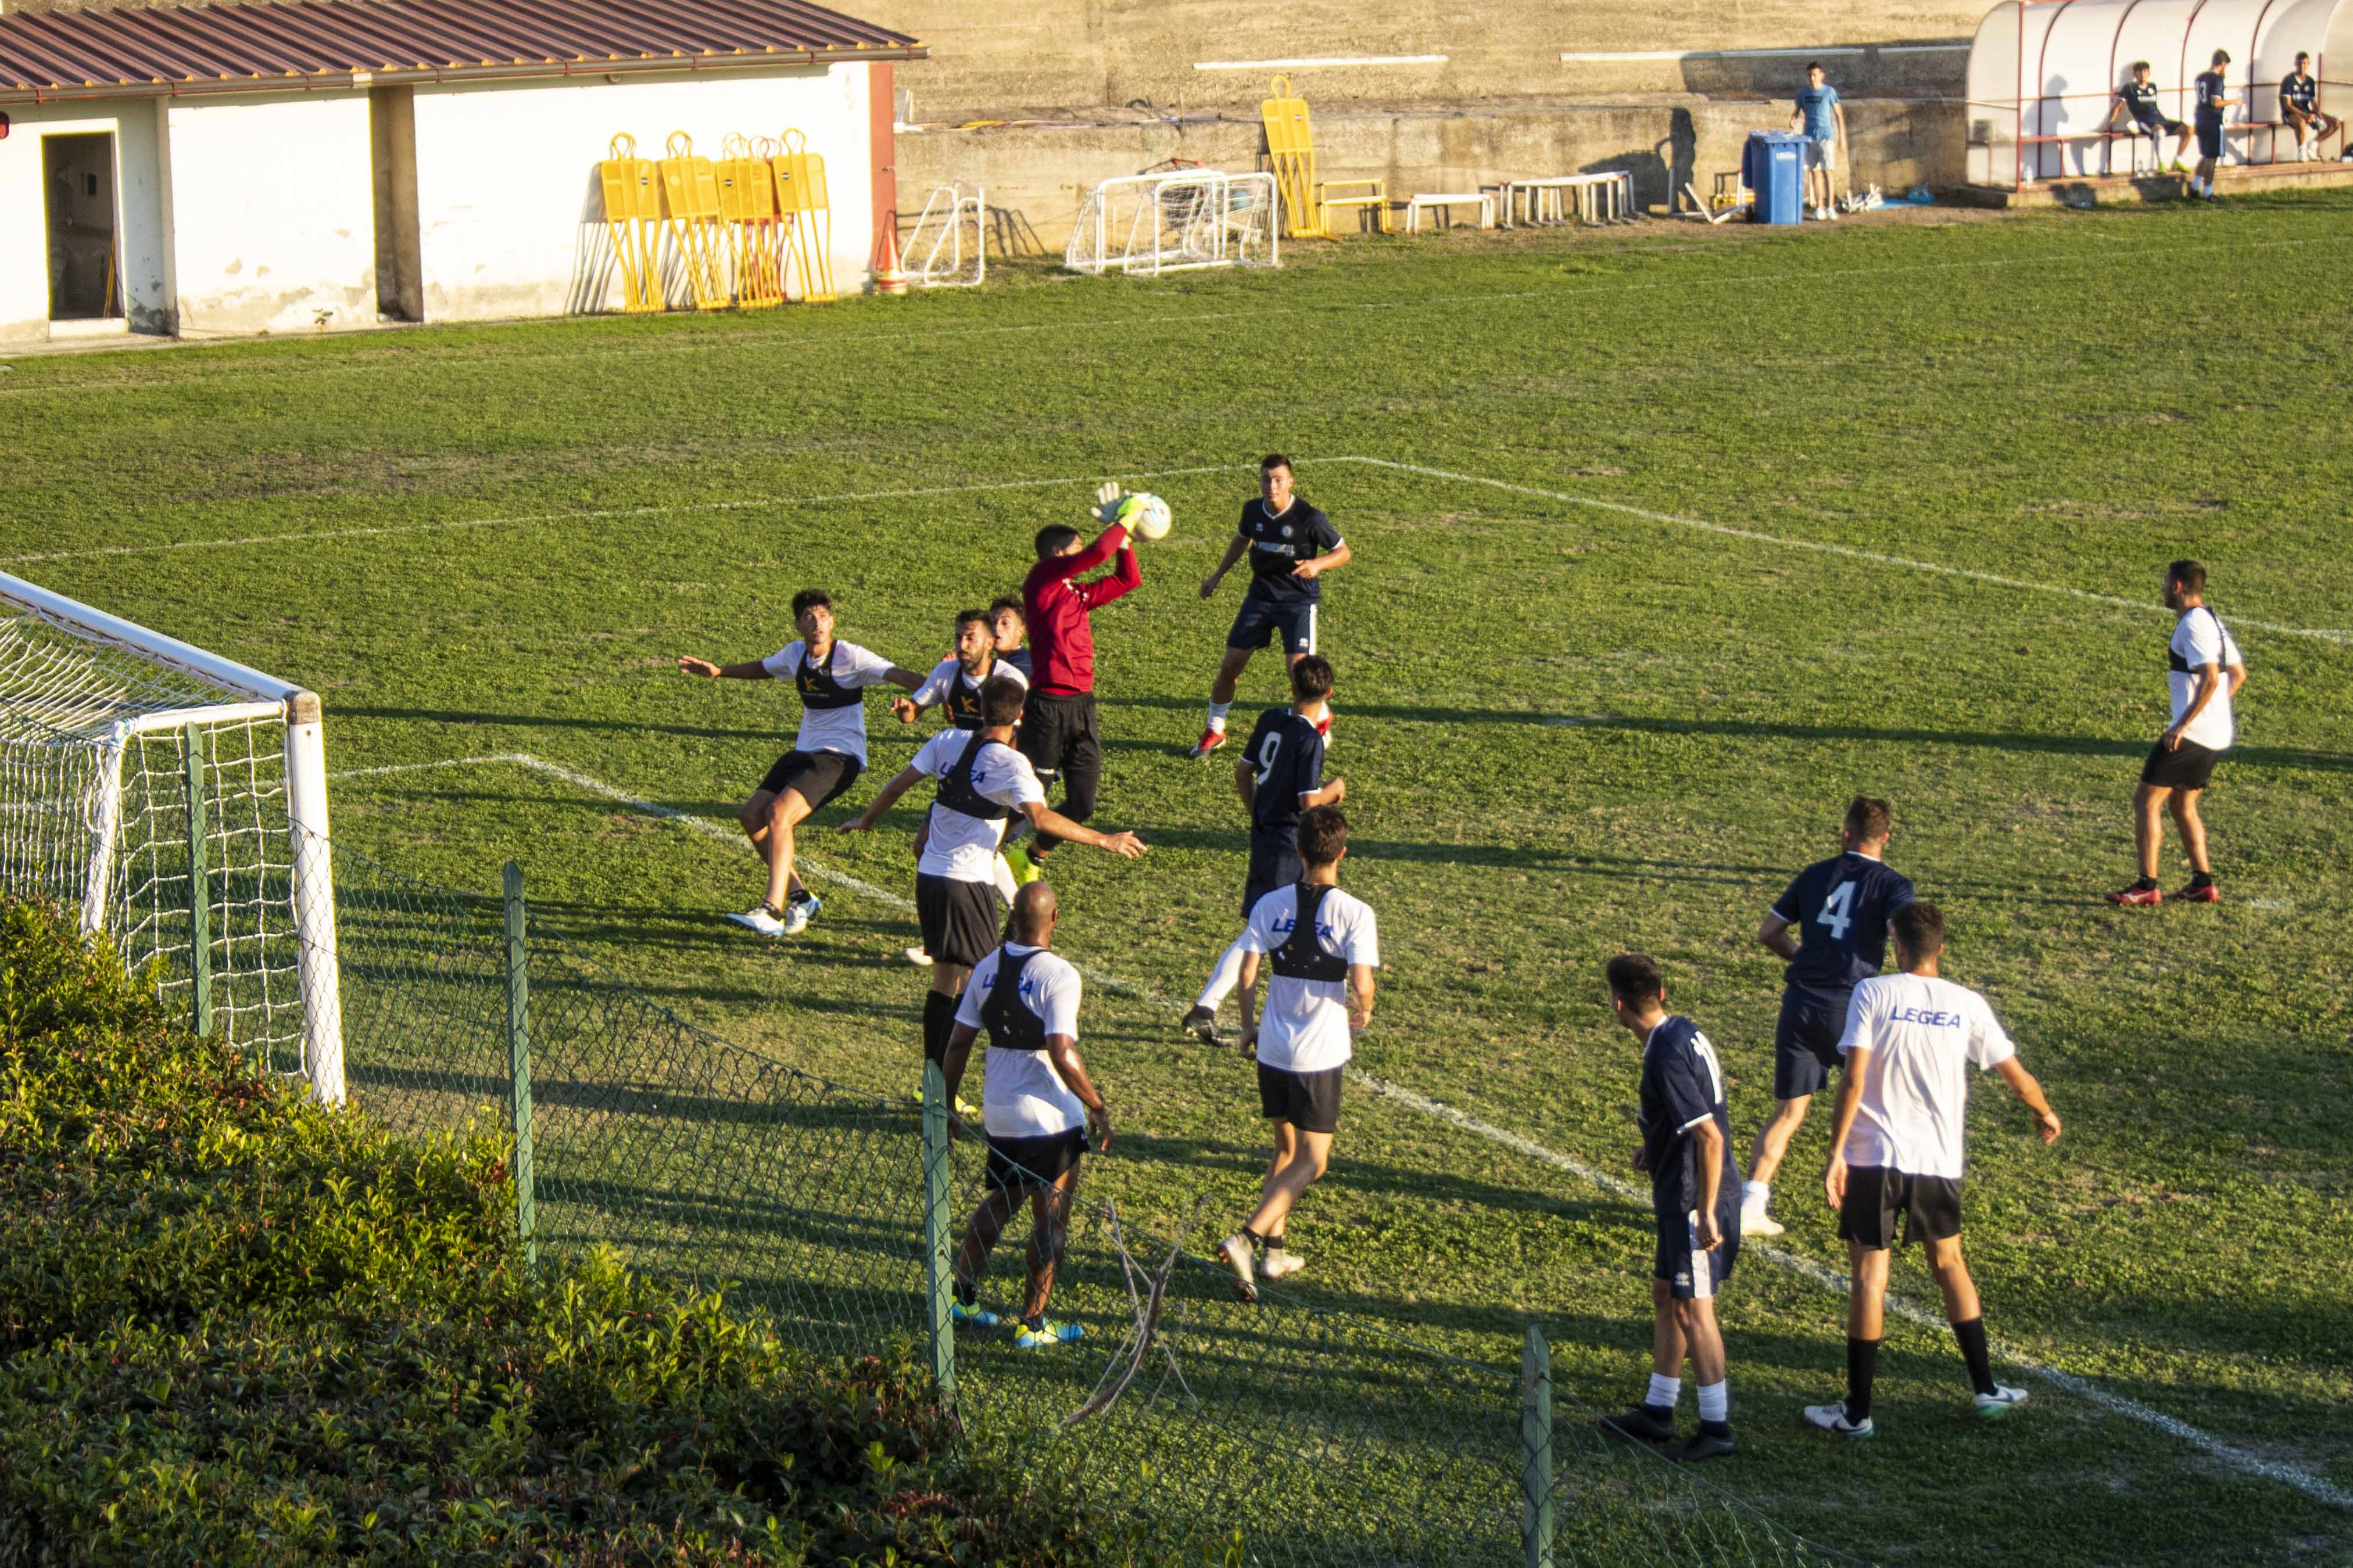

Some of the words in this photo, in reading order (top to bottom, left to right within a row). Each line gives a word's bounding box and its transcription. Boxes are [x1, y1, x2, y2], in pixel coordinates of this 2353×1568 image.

[1258, 731, 1281, 785] 9
[1817, 881, 1856, 939] 4
[1889, 1005, 1961, 1029] LEGEA
